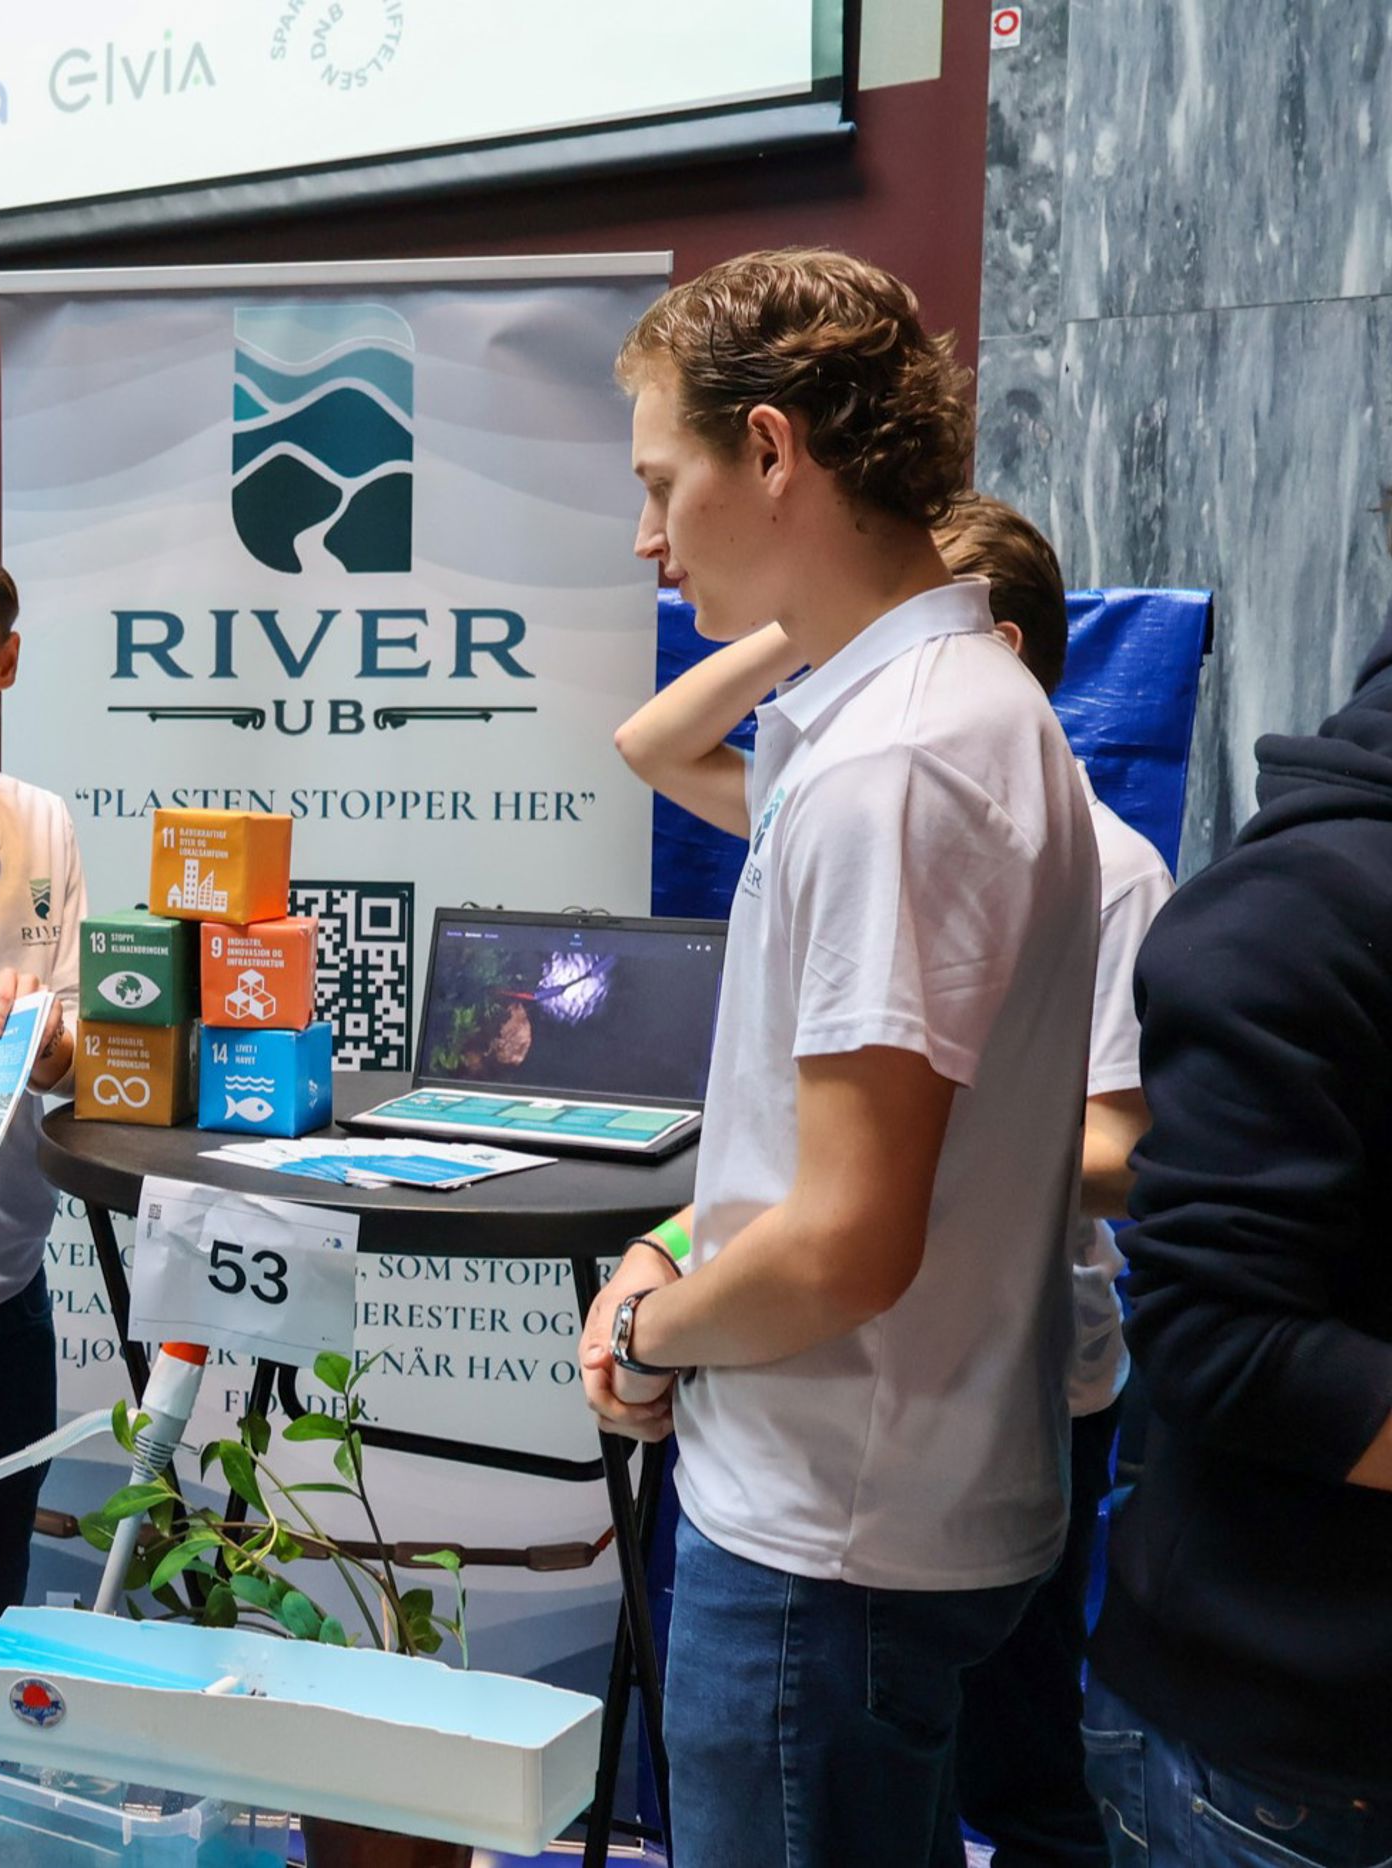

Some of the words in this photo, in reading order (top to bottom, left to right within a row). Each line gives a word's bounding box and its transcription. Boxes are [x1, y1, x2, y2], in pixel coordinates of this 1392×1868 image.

[110, 608, 536, 680] RIVER
[272, 699, 366, 736] UB
[290, 788, 478, 820] STOPPER
[162, 827, 176, 849] 11
[90, 931, 106, 954] 13
[211, 936, 223, 959] 9
[84, 1034, 101, 1057] 12
[211, 1042, 228, 1065] 14
[207, 1239, 289, 1305] 53
[378, 1255, 452, 1282] SOM
[464, 1259, 611, 1287] STOPPR
[523, 1310, 575, 1337] OG
[382, 1346, 456, 1379] NÅR
[468, 1356, 540, 1382] HAV
[550, 1359, 583, 1386] O
